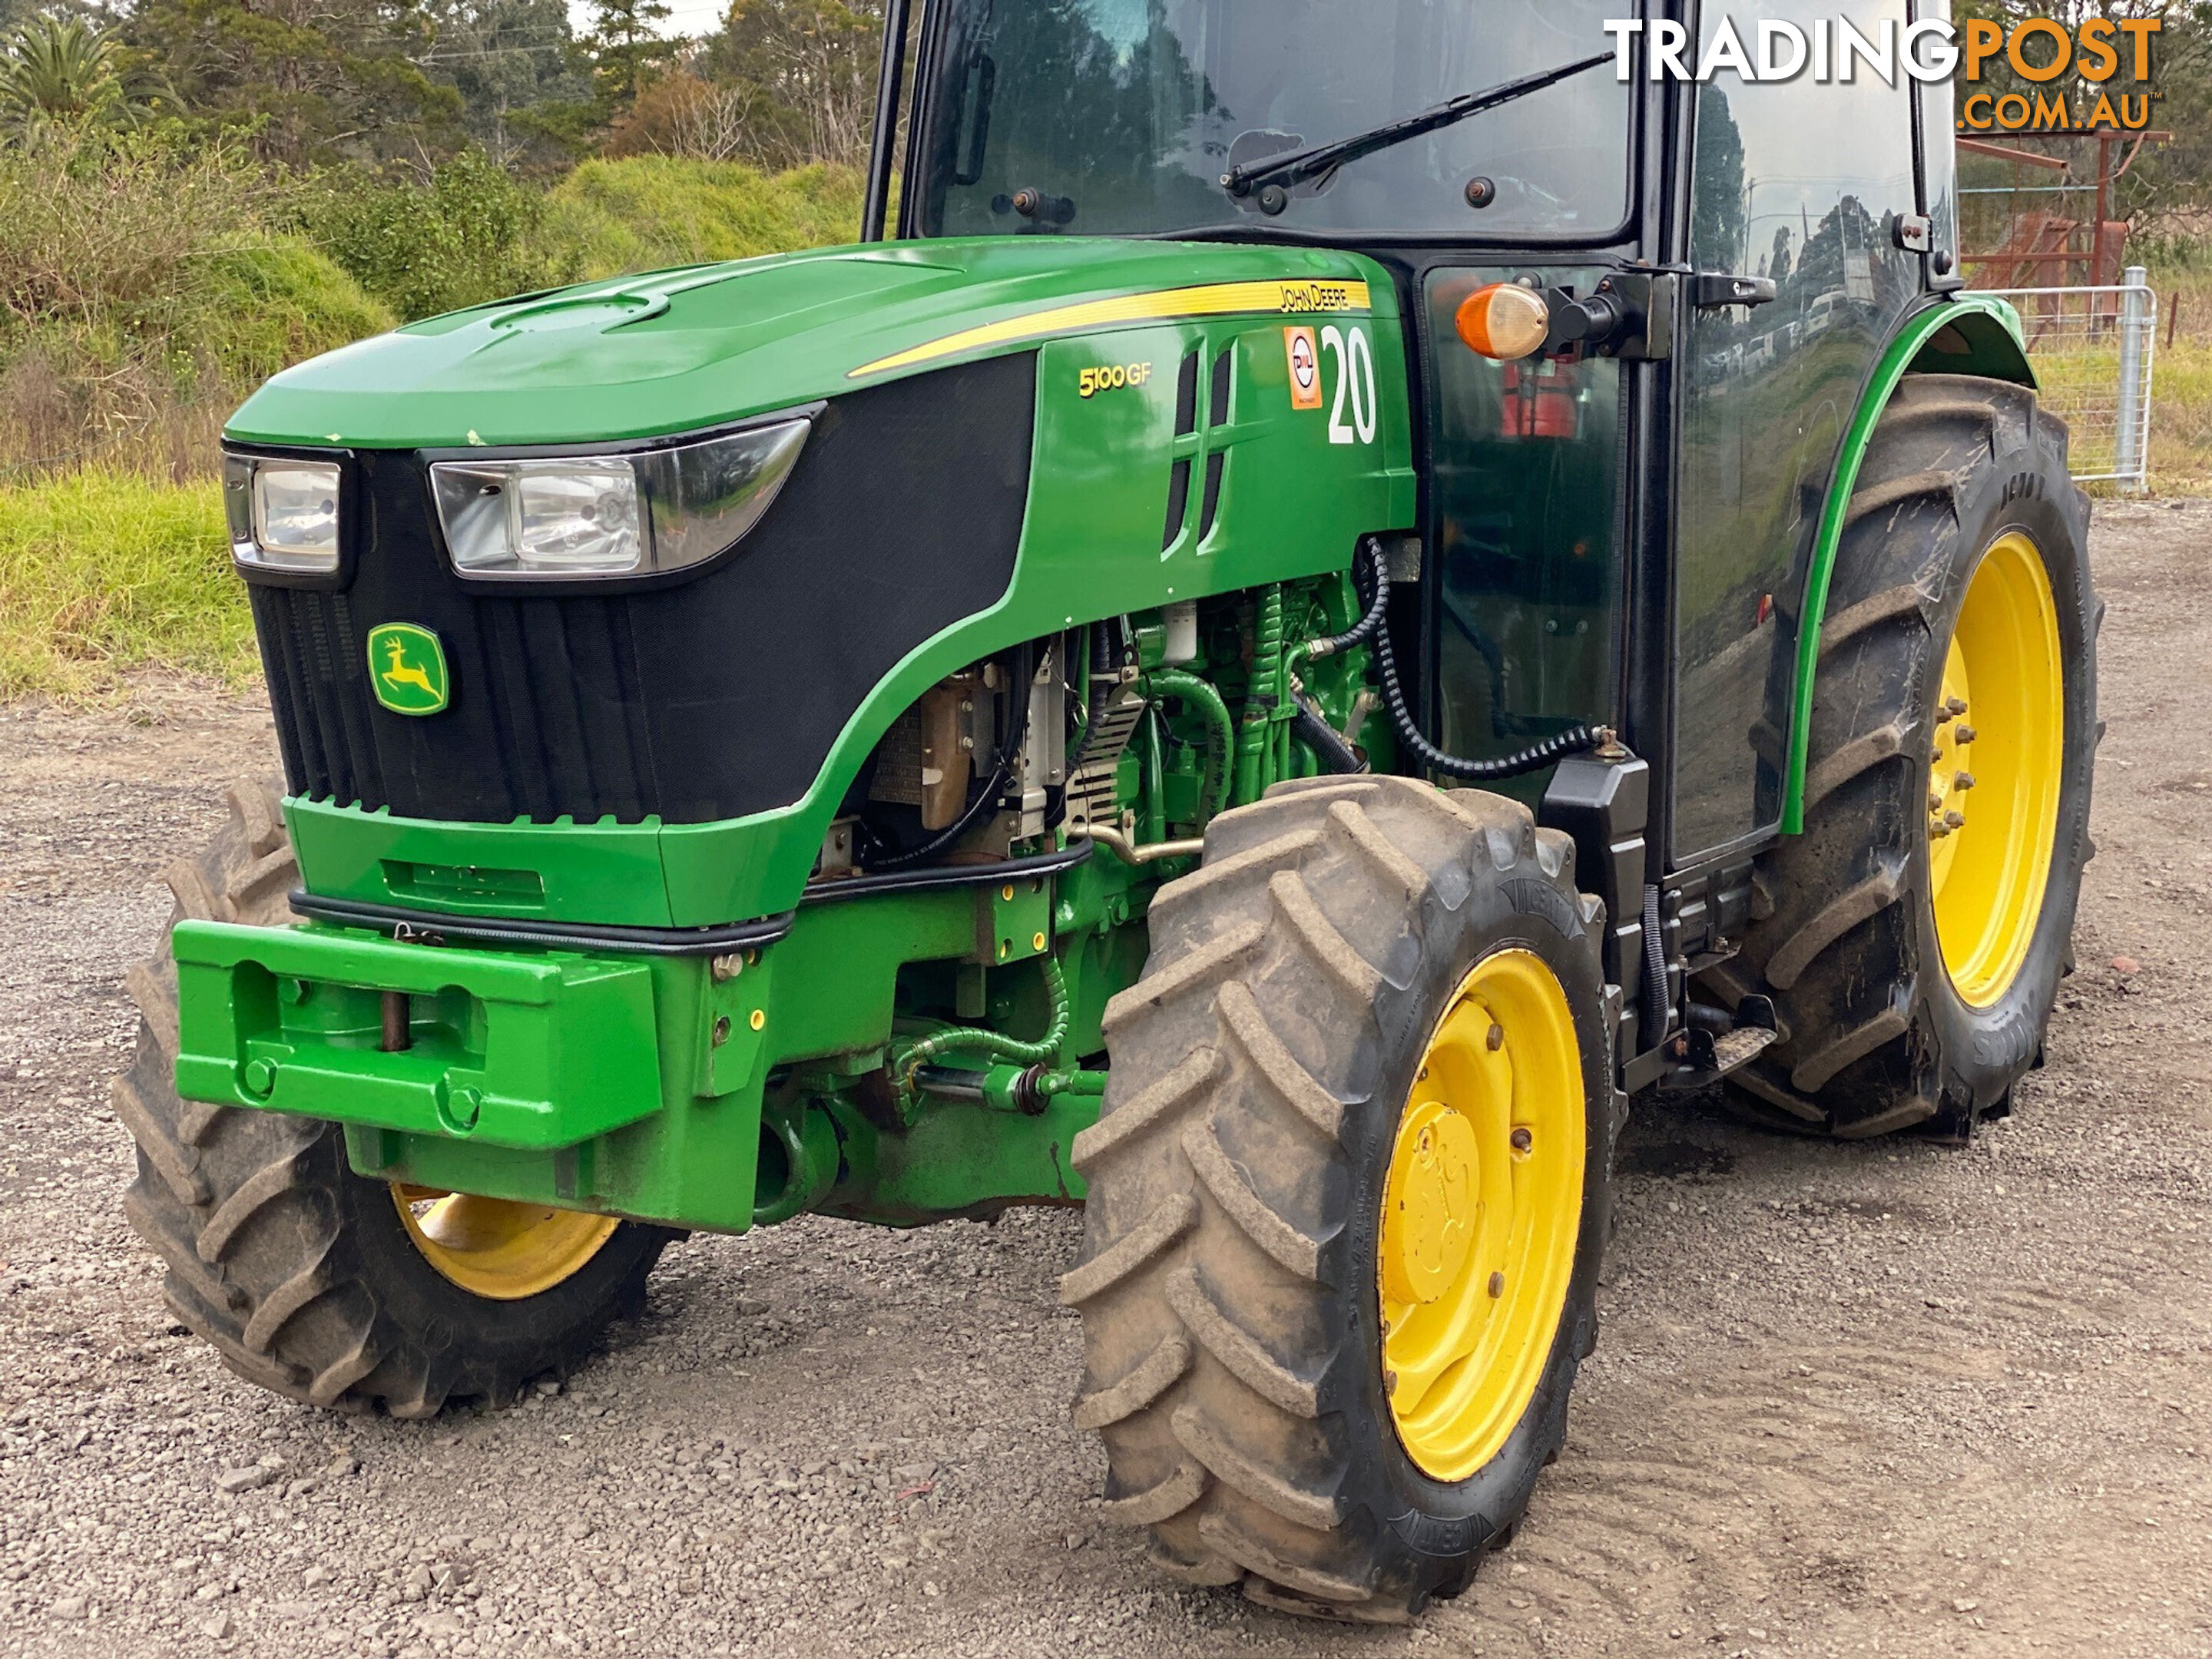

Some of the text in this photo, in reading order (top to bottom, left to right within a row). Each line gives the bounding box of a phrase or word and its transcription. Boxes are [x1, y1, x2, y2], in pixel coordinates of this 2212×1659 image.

[1280, 284, 1349, 309] JOHN DEERE
[1320, 325, 1376, 444] 20
